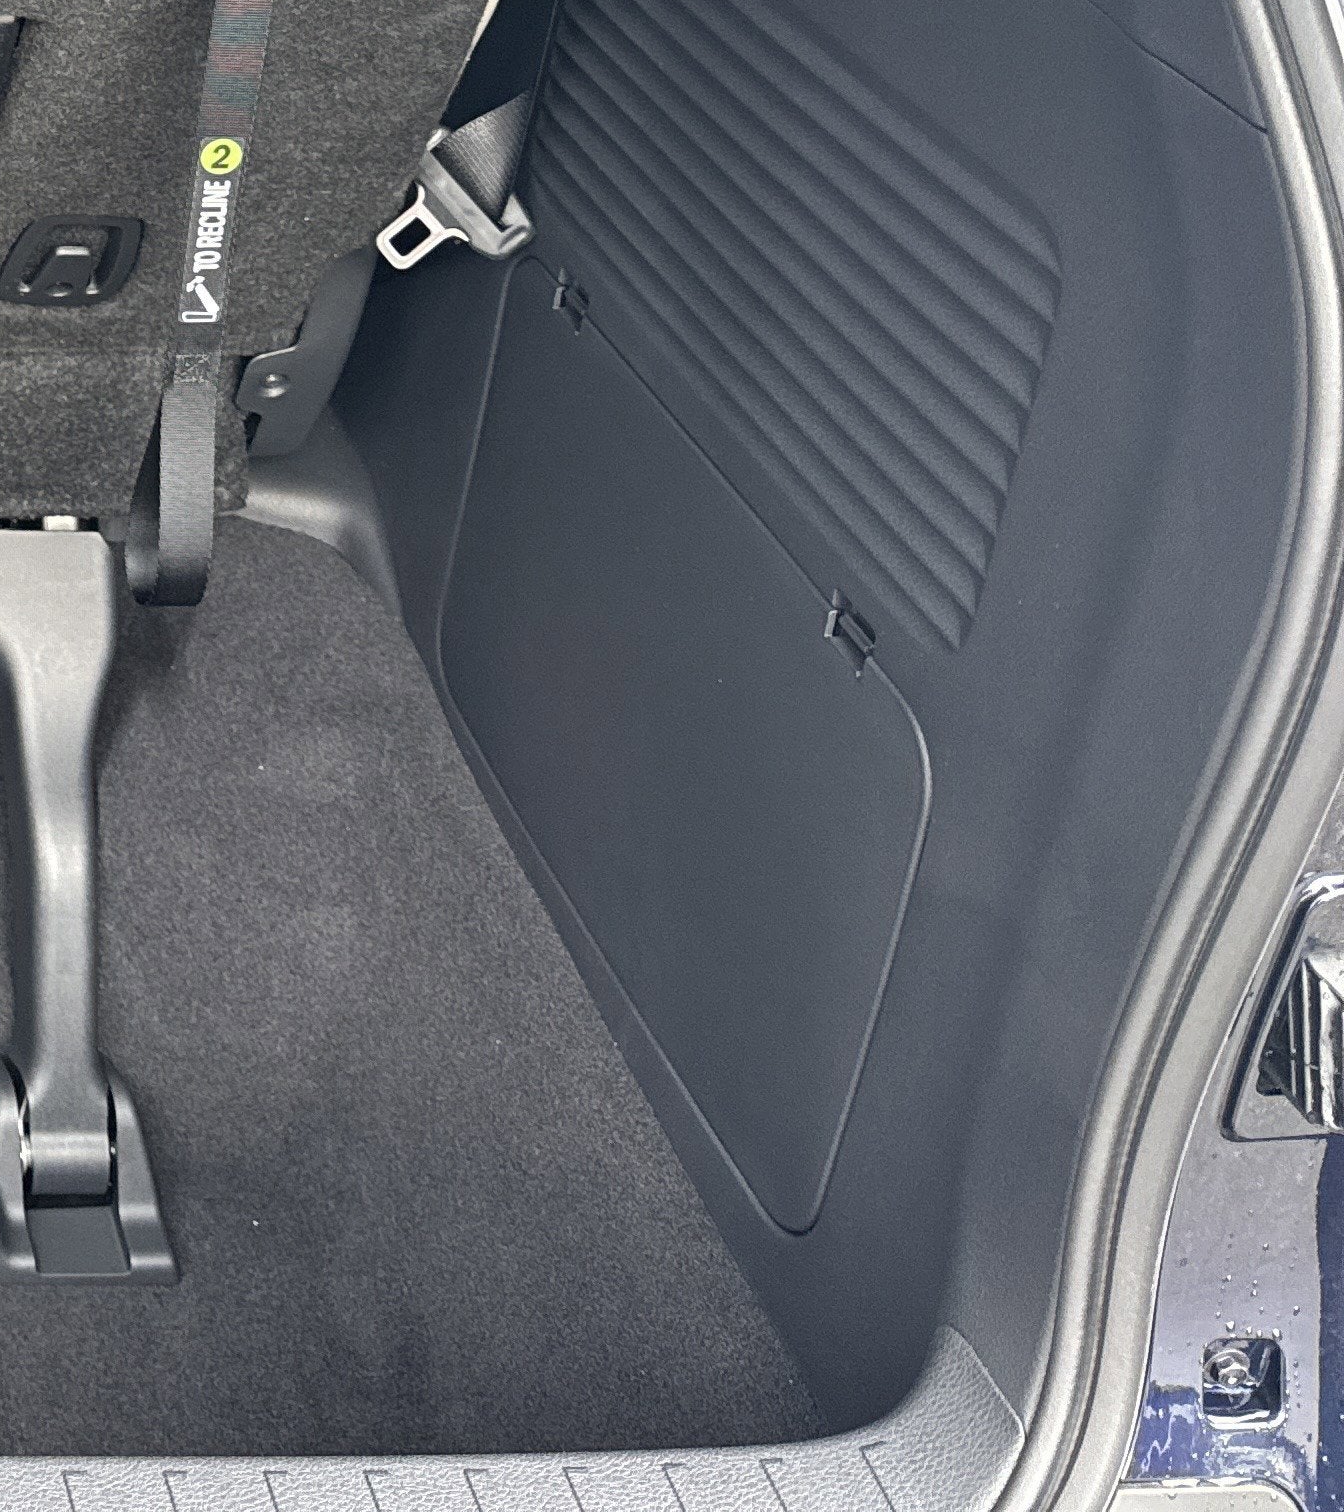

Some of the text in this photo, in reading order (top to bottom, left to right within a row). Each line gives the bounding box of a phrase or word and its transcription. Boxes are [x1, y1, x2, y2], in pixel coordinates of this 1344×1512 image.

[210, 144, 231, 169] 2
[193, 180, 231, 273] TO RECLINE
